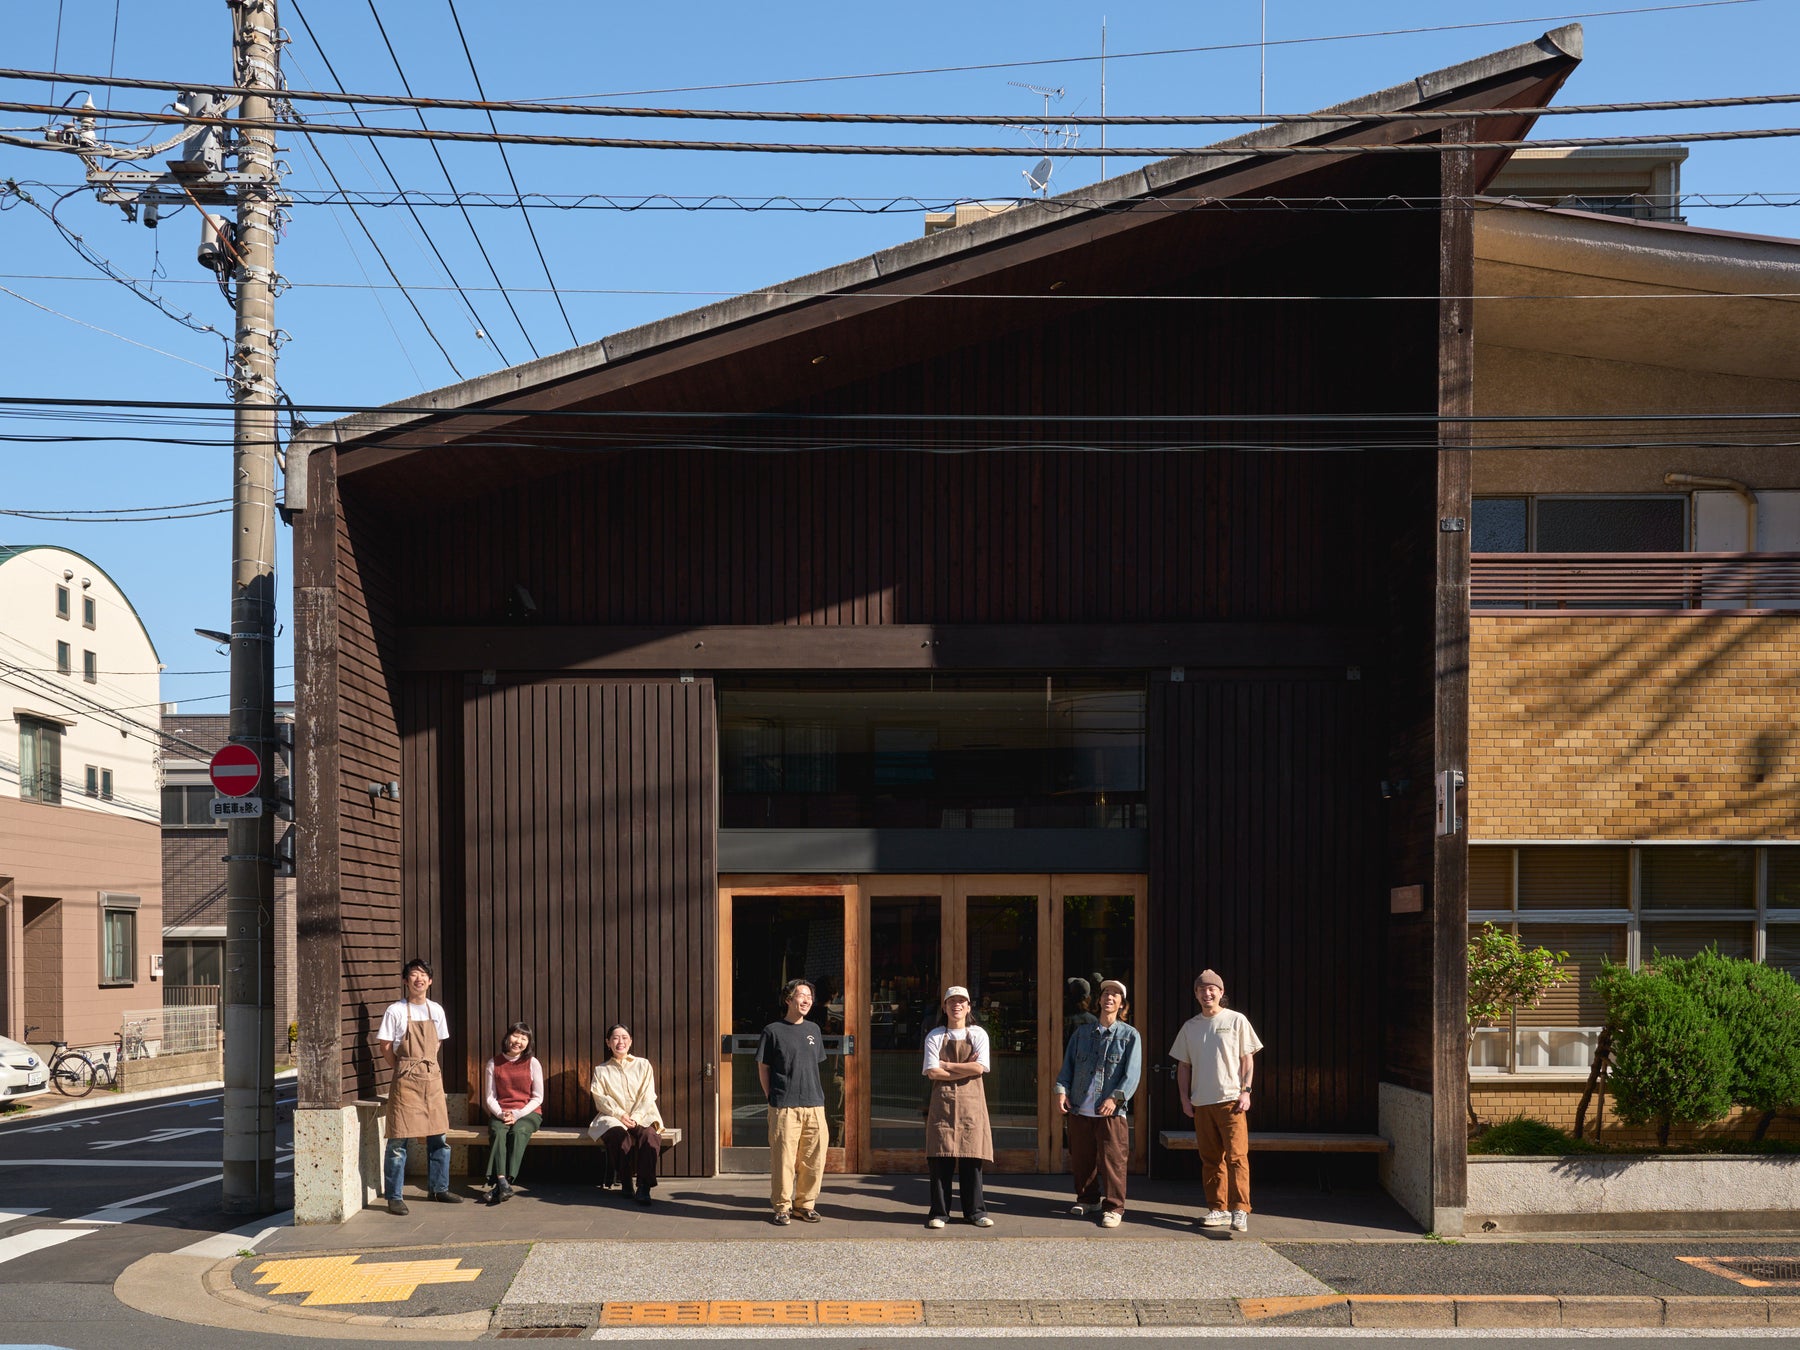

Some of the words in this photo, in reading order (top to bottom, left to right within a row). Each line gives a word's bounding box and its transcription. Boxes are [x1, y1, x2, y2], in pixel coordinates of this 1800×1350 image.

[214, 802, 258, 814] 自転車を除く
